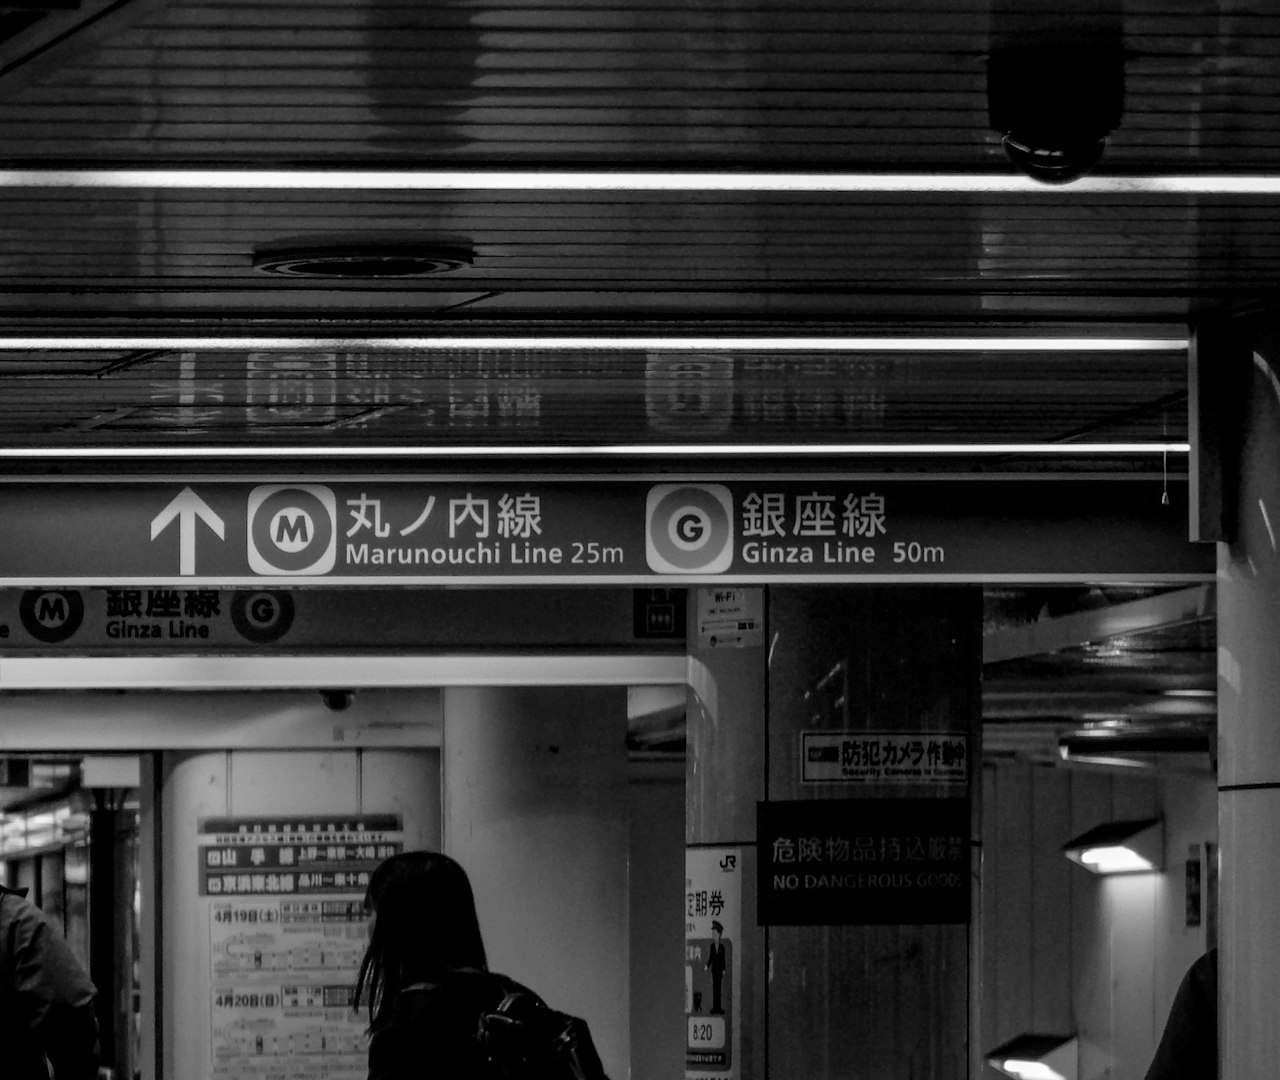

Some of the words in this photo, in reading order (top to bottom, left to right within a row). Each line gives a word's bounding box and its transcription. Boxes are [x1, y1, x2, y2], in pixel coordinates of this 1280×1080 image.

[345, 491, 544, 539] 丸ノ内線
[741, 491, 888, 537] 銀座線
[272, 515, 310, 542] M
[676, 515, 704, 542] G
[345, 543, 501, 565] Marunouchi
[510, 543, 563, 565] Line
[570, 541, 625, 564] 25m
[741, 541, 815, 565] Ginza
[822, 541, 876, 565] Line
[892, 541, 946, 564] 50m
[106, 621, 161, 638] Ginza
[169, 621, 210, 638] Line
[719, 855, 736, 868] JR
[772, 836, 963, 864] 危険物品持込厳禁
[772, 873, 799, 890] NO
[804, 873, 912, 889] DANGEROUS
[916, 872, 962, 888] GOODS
